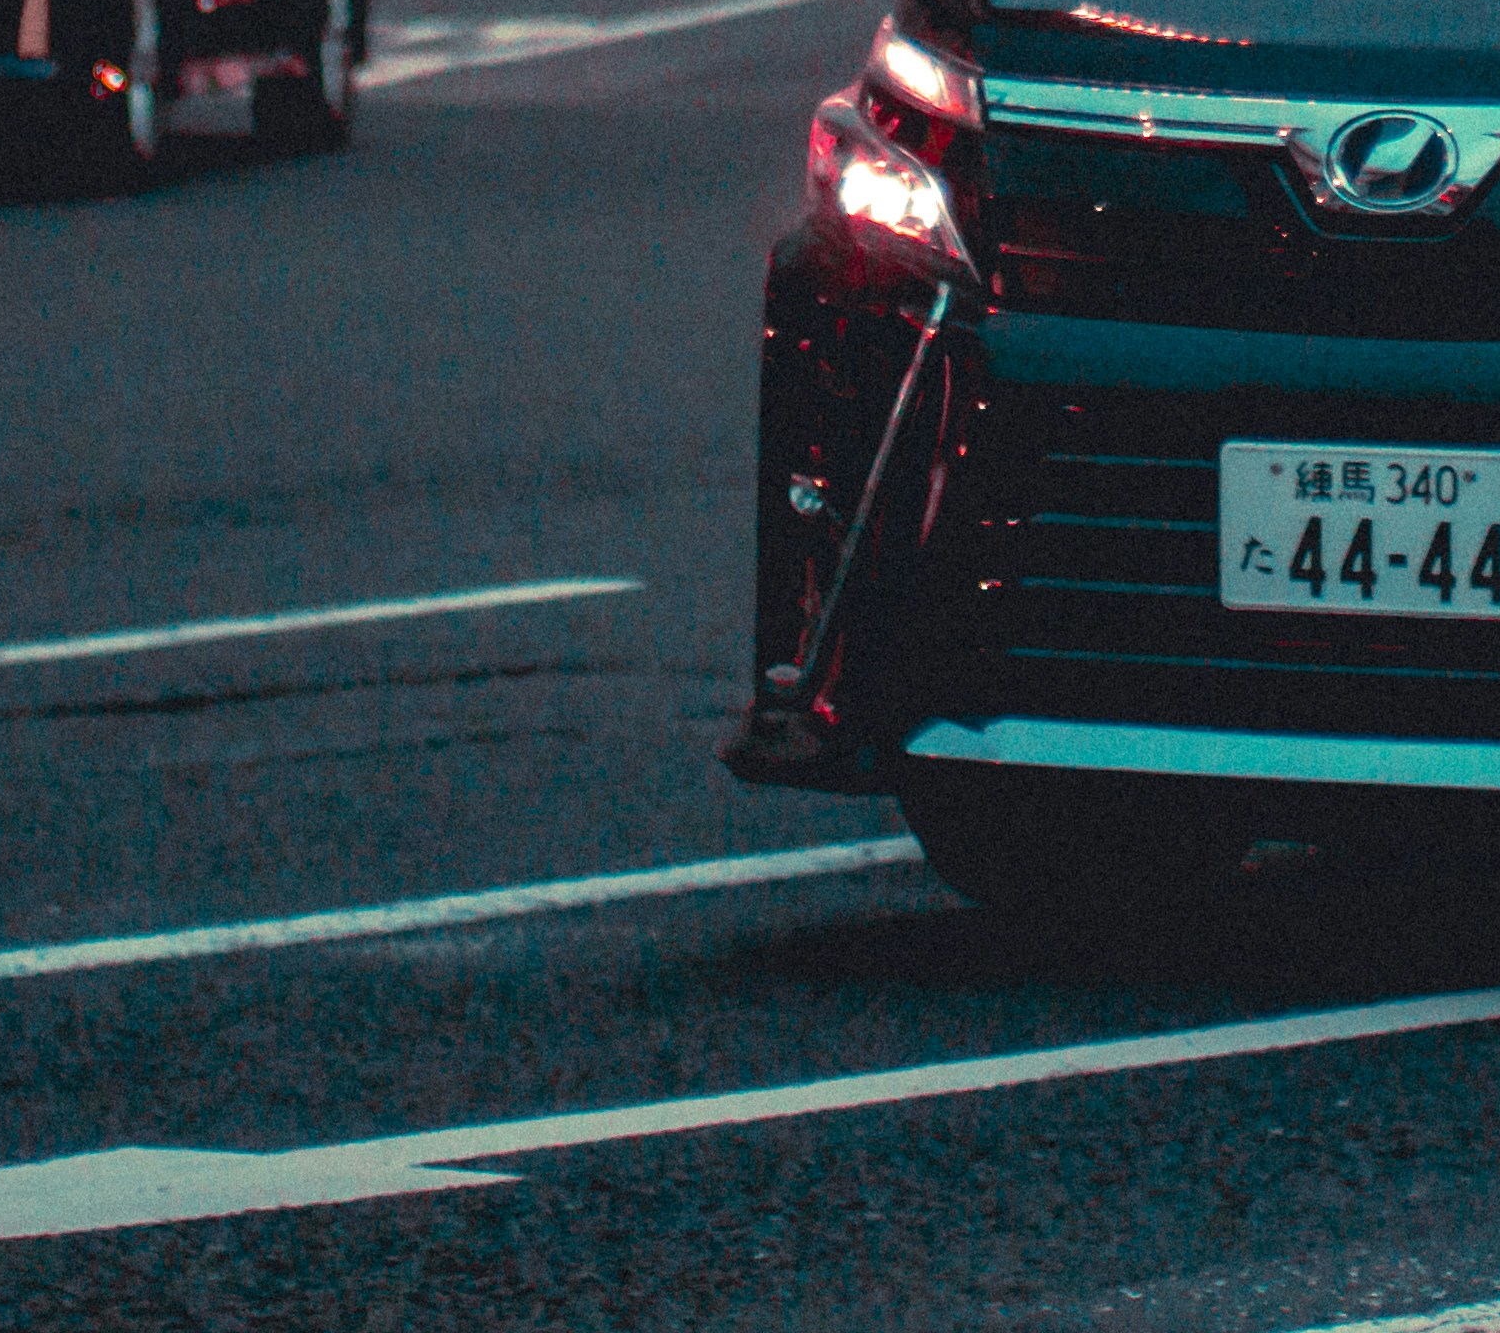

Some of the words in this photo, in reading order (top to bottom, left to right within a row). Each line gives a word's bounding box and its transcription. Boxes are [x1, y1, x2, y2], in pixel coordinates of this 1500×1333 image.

[1294, 460, 1376, 505] 練馬
[1385, 463, 1460, 508] 340
[1240, 536, 1274, 576] た
